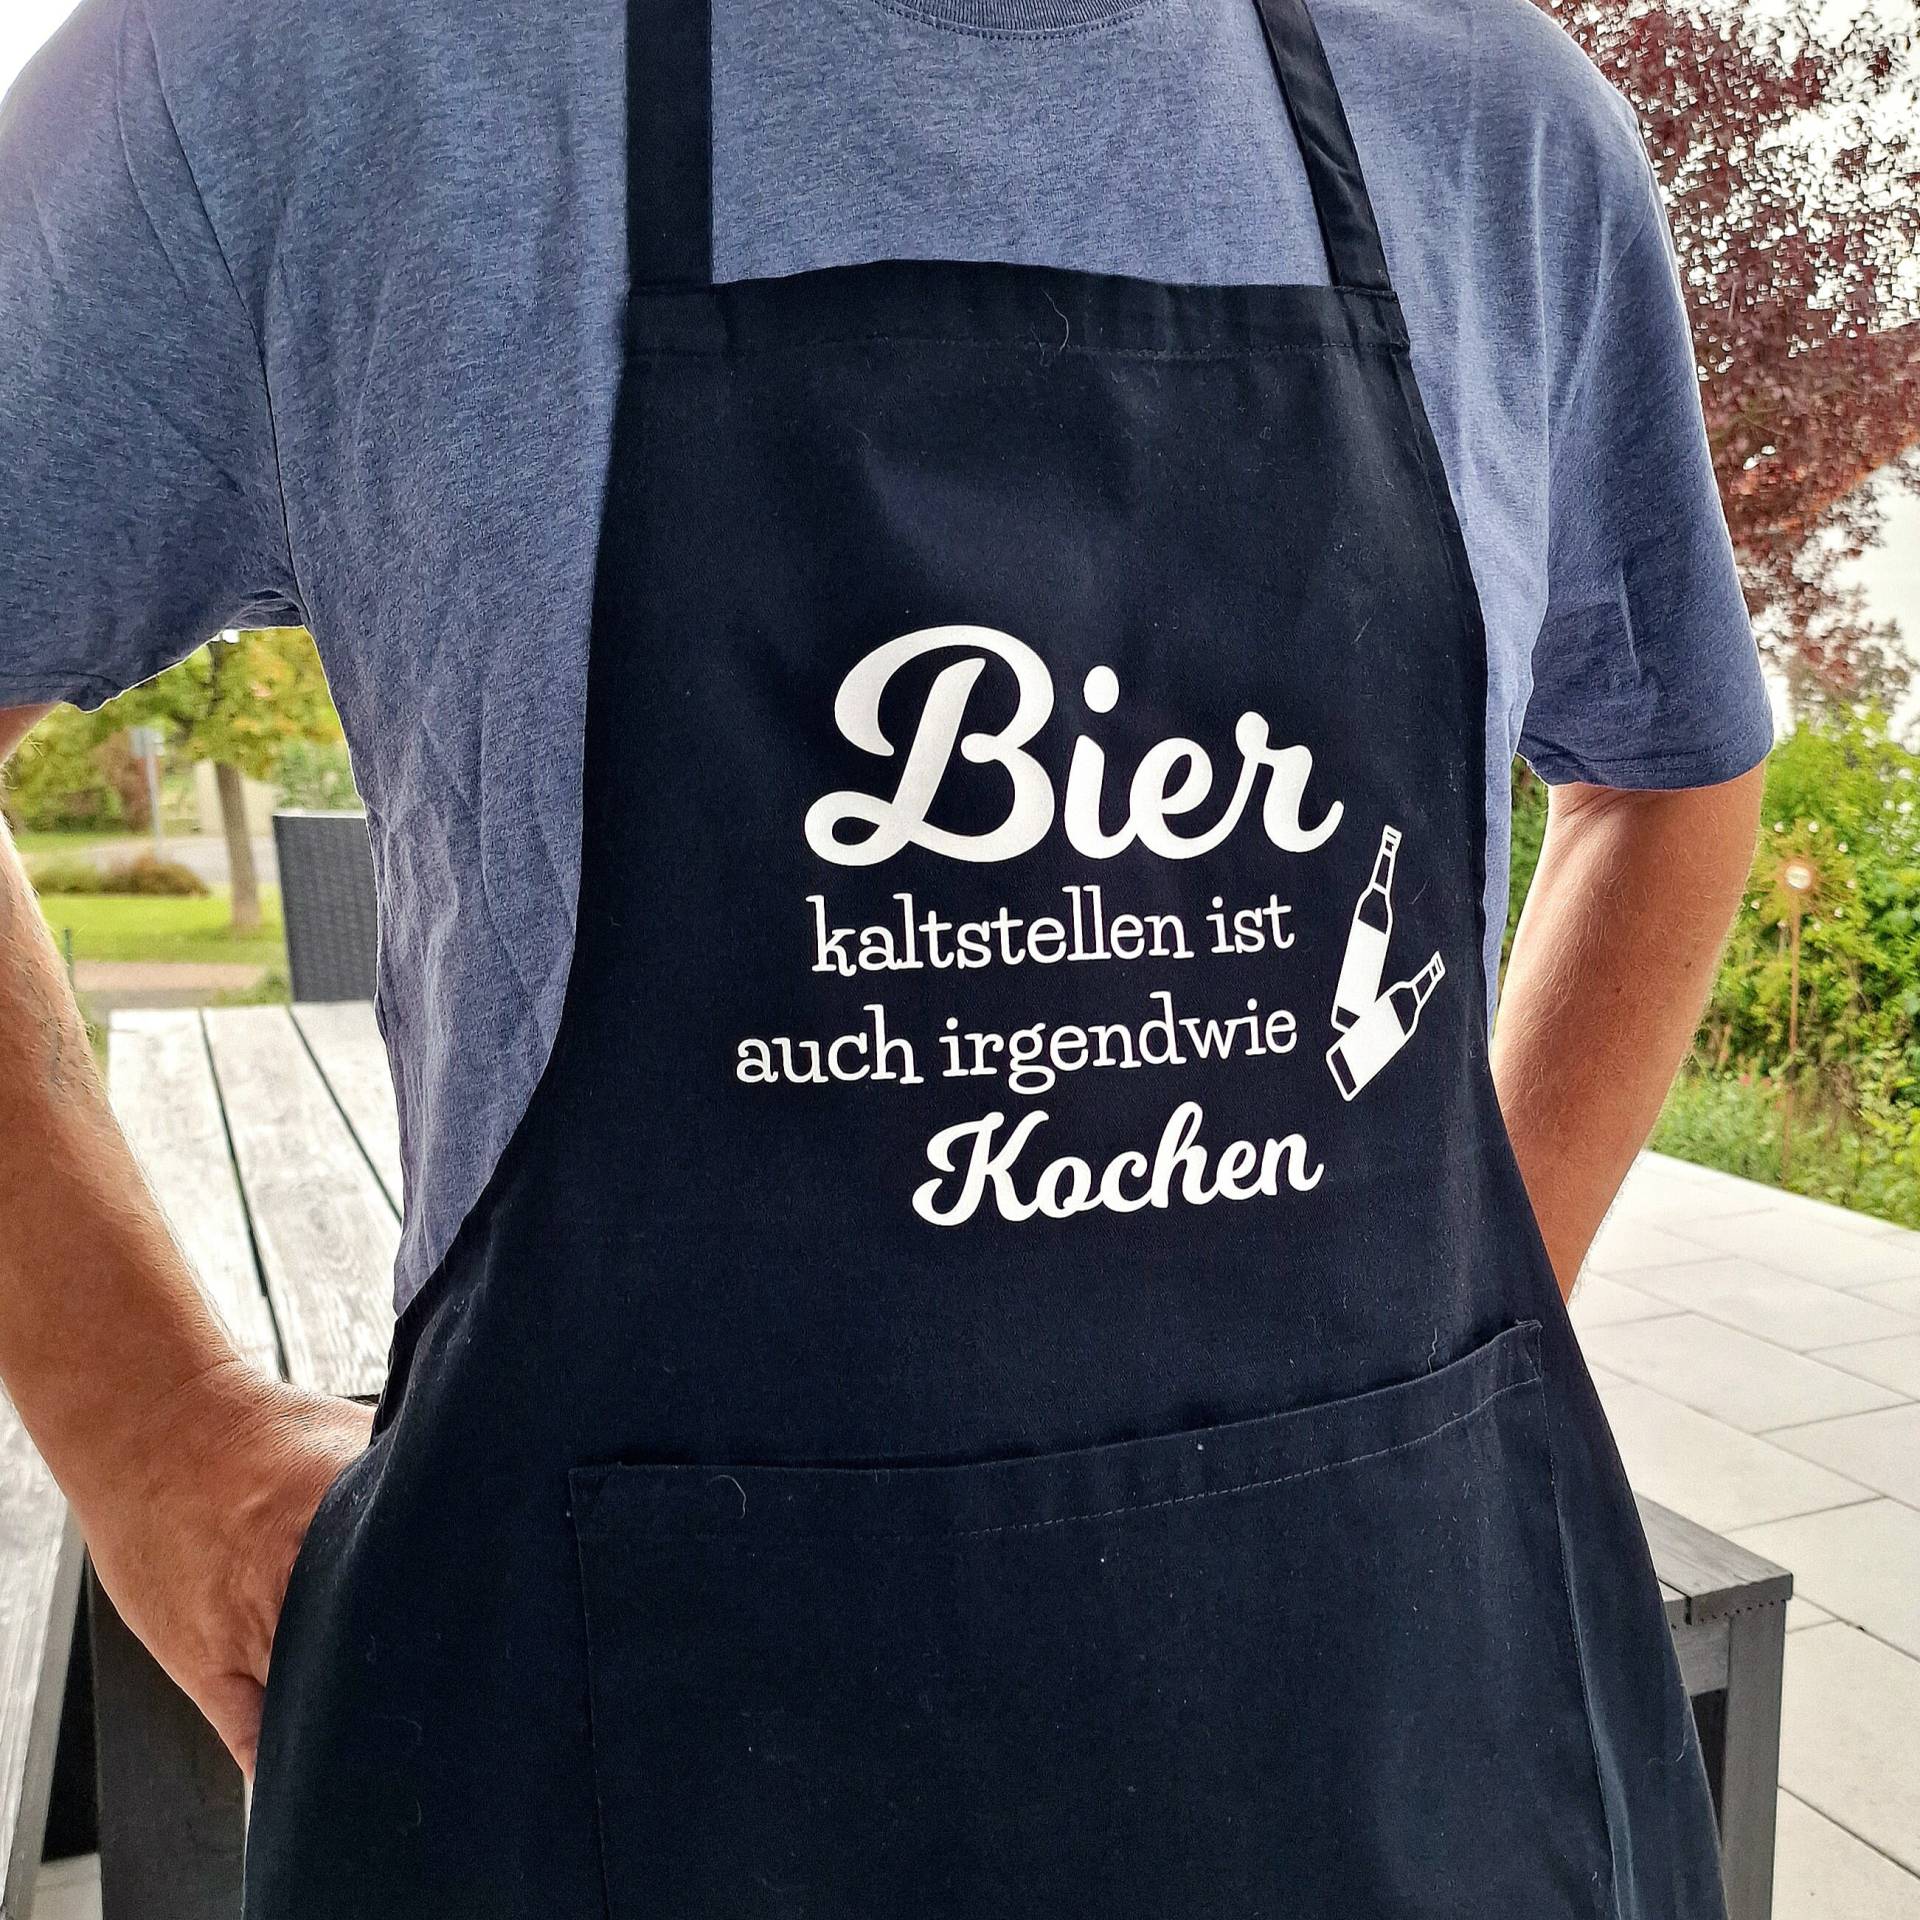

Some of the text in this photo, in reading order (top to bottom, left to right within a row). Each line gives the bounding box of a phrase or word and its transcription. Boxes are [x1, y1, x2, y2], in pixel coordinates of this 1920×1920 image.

[804, 624, 1345, 867] Bier
[805, 884, 1295, 977] kaltstellen ist
[736, 990, 1298, 1095] auch irgendwie
[911, 1101, 1325, 1227] Kochen
